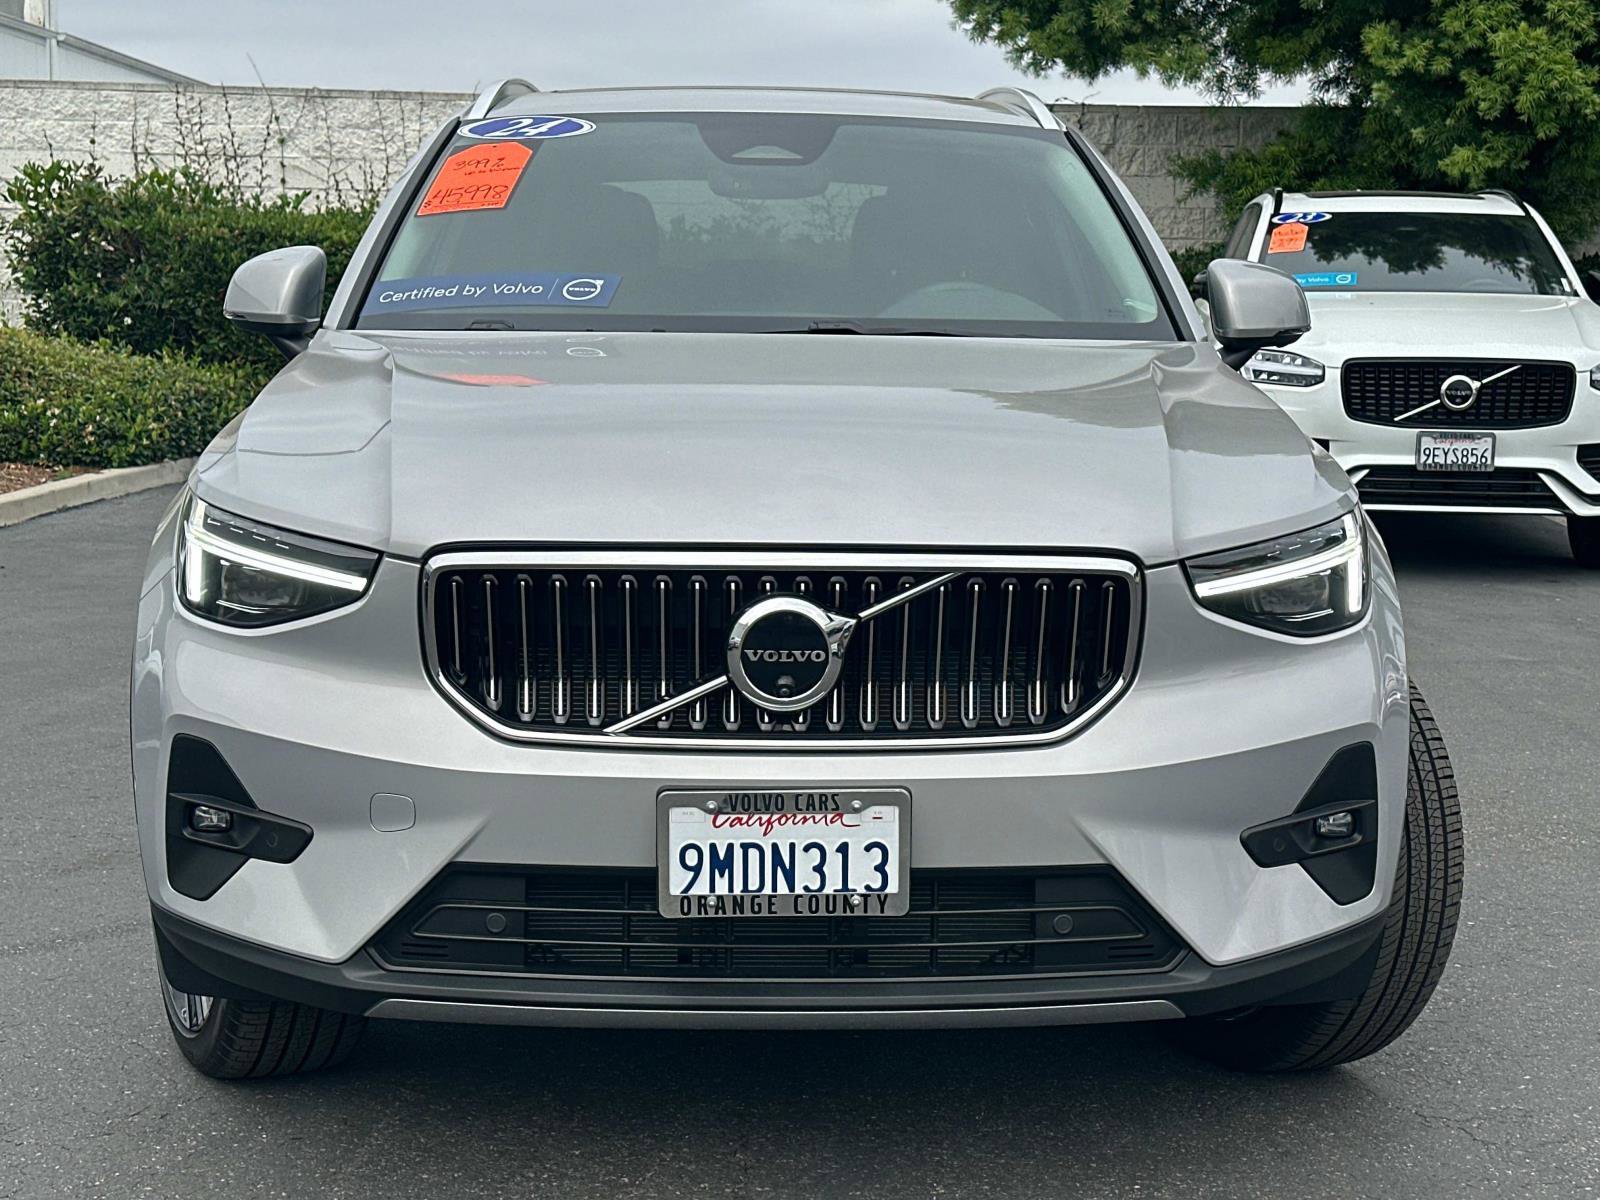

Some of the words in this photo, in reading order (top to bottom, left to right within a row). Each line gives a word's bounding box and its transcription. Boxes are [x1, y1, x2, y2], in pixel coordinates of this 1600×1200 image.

[484, 118, 569, 138] 24
[379, 284, 459, 304] Certified
[463, 281, 487, 297] by
[493, 282, 544, 295] Volvo
[1423, 447, 1489, 465] 9EYS856
[743, 649, 827, 663] VOLVO
[728, 794, 786, 813] VOLVO
[794, 794, 841, 812] CARS
[711, 812, 861, 838] California
[678, 841, 890, 894] 9MDN313
[679, 895, 779, 916] ORANGE
[793, 893, 890, 915] COUNTY
